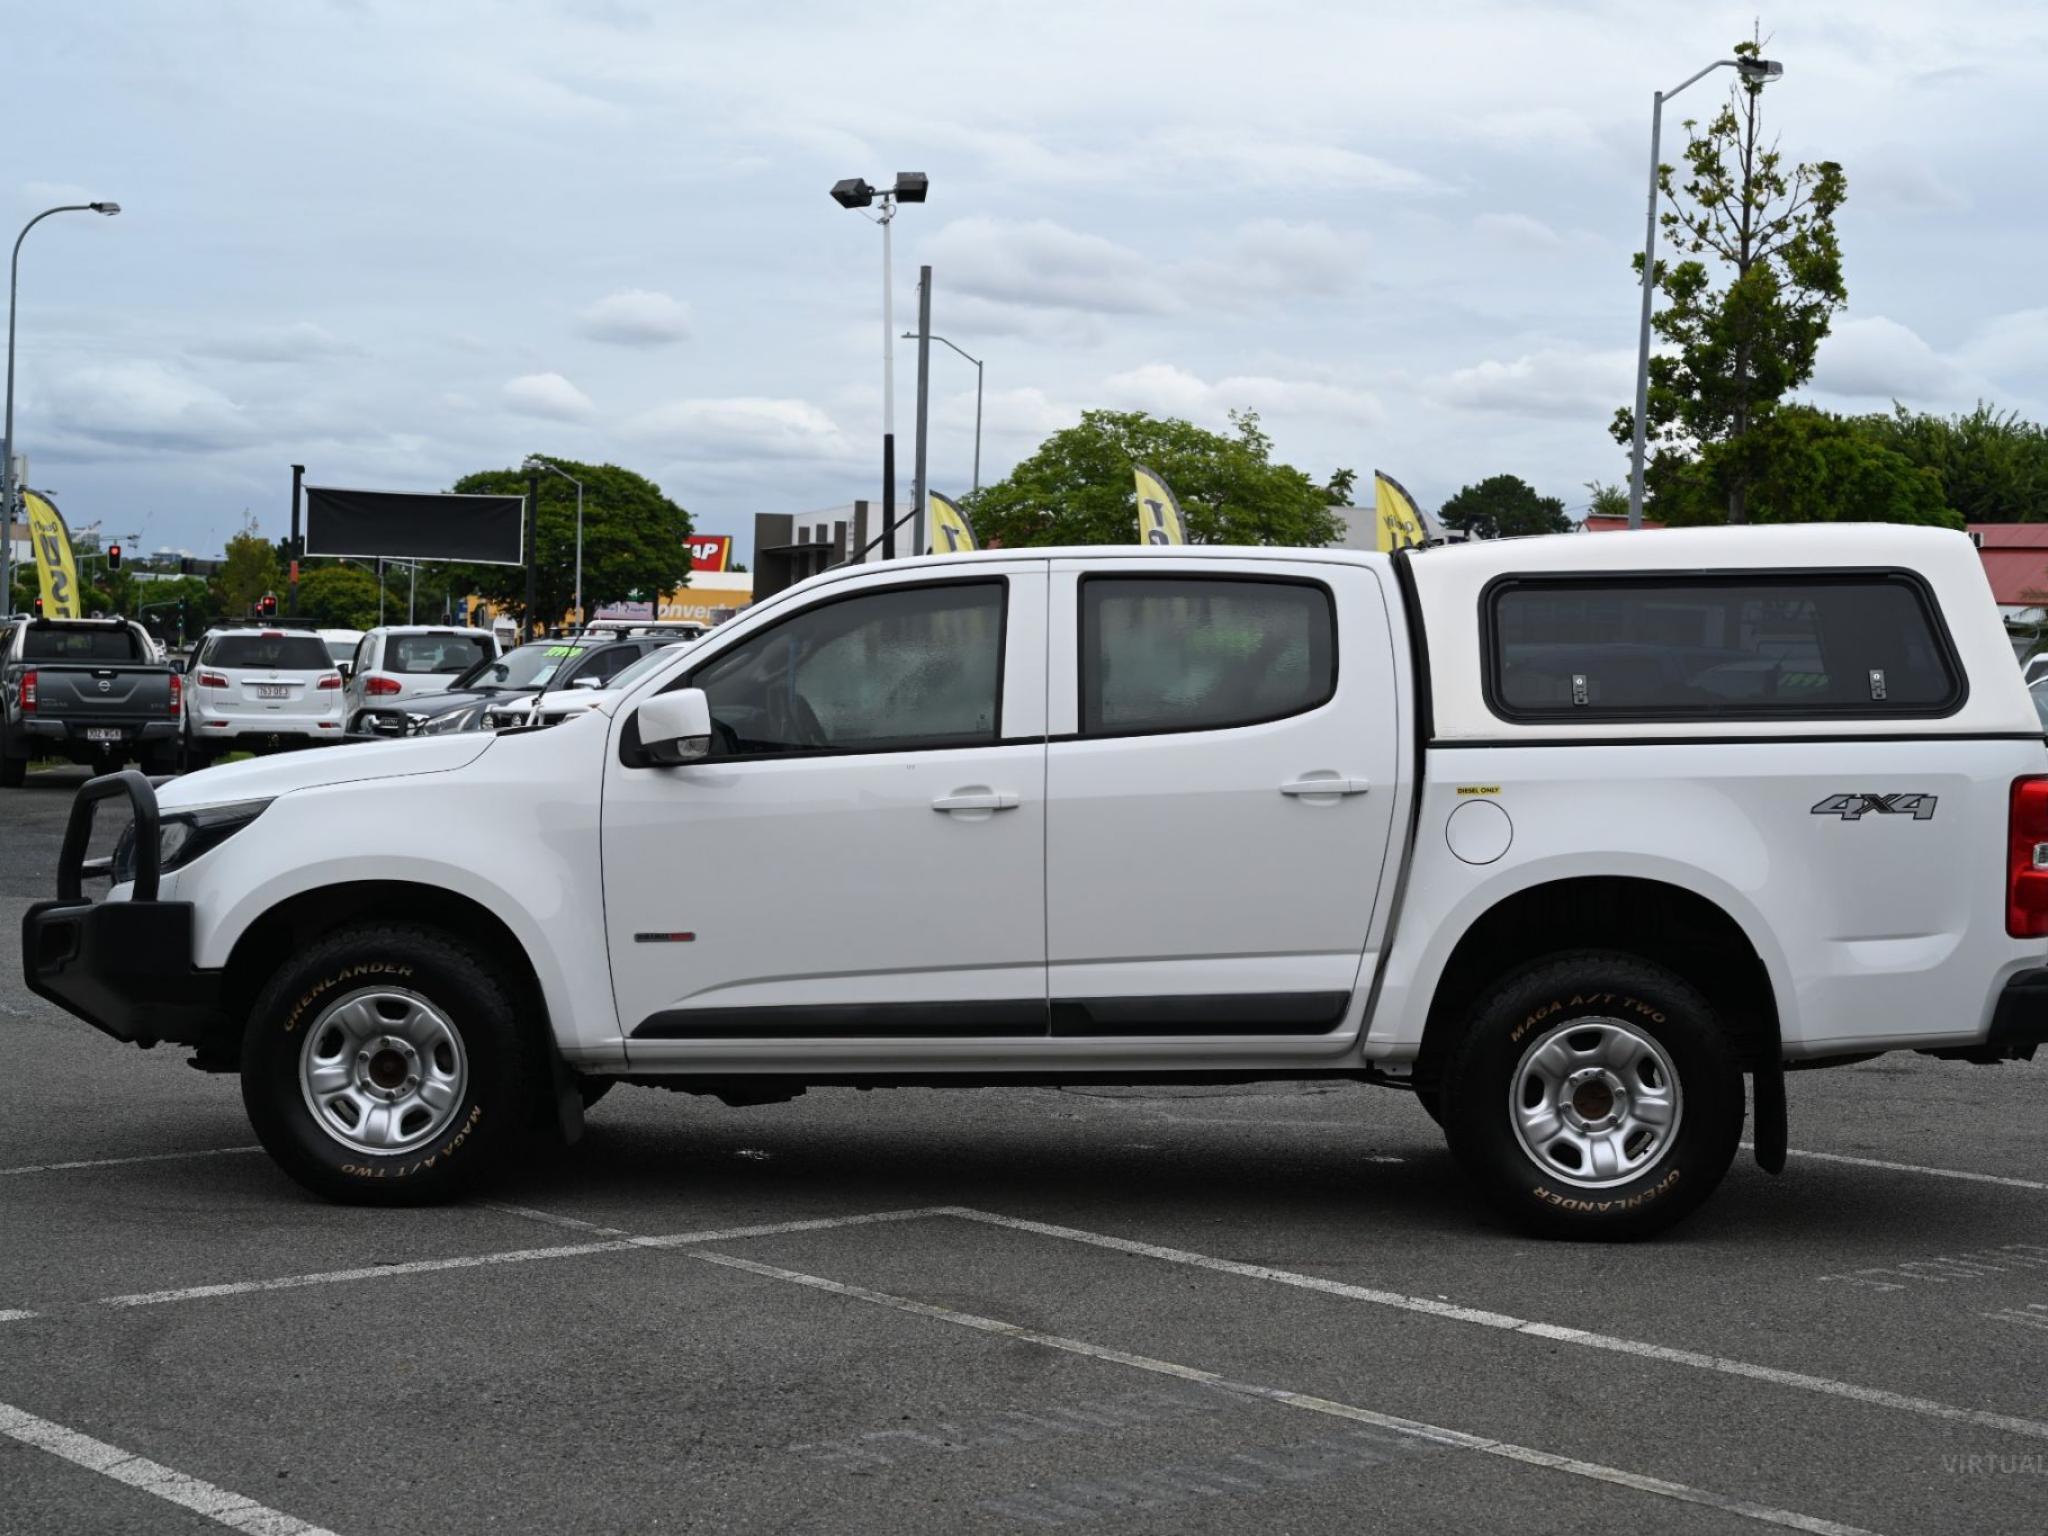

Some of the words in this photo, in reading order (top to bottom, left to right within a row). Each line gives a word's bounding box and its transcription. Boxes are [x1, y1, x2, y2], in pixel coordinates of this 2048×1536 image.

[1480, 786, 1500, 794] ONLY
[1509, 1001, 1562, 1042] MAGA
[1623, 997, 1666, 1023] TWO
[442, 1104, 483, 1157] MAGA
[341, 1162, 386, 1179] TWO
